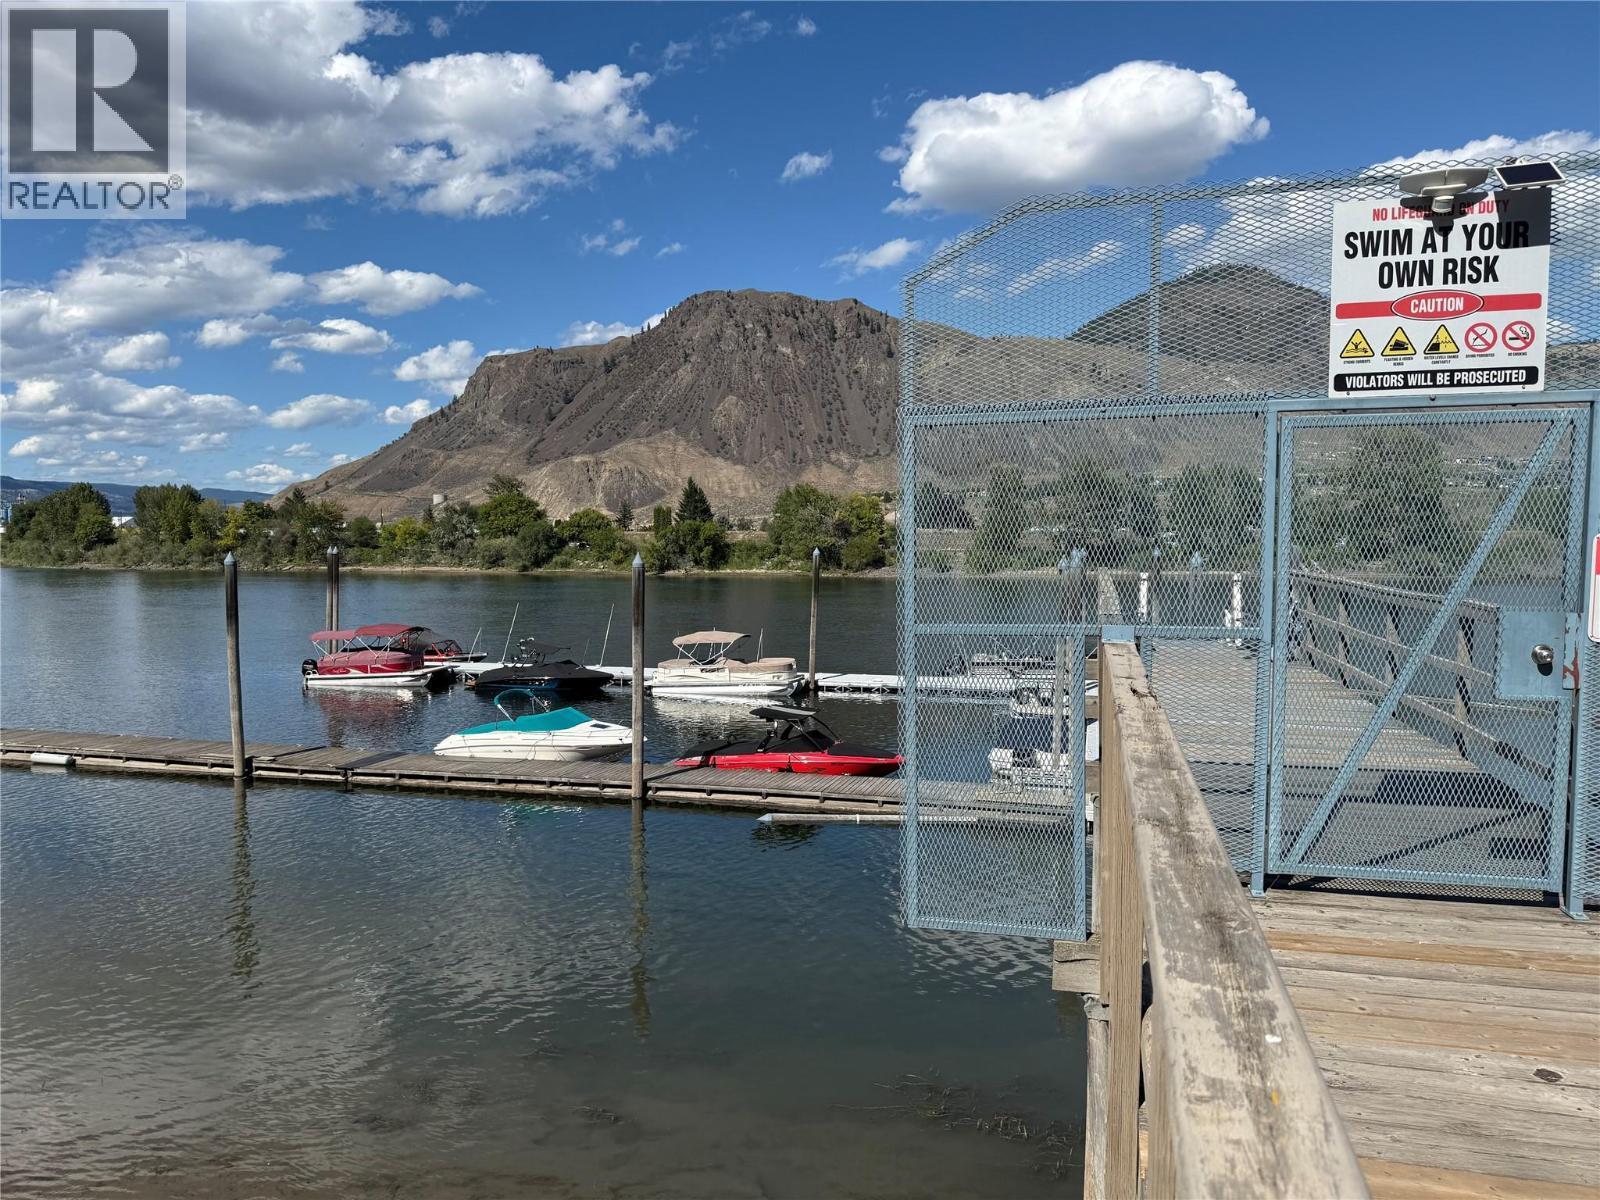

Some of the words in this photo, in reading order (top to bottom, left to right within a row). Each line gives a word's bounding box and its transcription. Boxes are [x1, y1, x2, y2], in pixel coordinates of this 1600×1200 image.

[1372, 208, 1388, 222] NO
[1460, 202, 1474, 216] ON
[1479, 199, 1510, 215] DUTY
[1344, 228, 1413, 259] SWIM
[1421, 226, 1450, 254] AT
[1462, 220, 1530, 252] YOUR
[1378, 258, 1434, 290] OWN
[1443, 255, 1500, 284] RISK
[1410, 297, 1464, 314] CAUTION
[1345, 373, 1404, 389] VIOLATORS
[1407, 372, 1433, 386] WILL
[1436, 371, 1450, 385] BE
[1453, 369, 1527, 385] PROSECUTED
